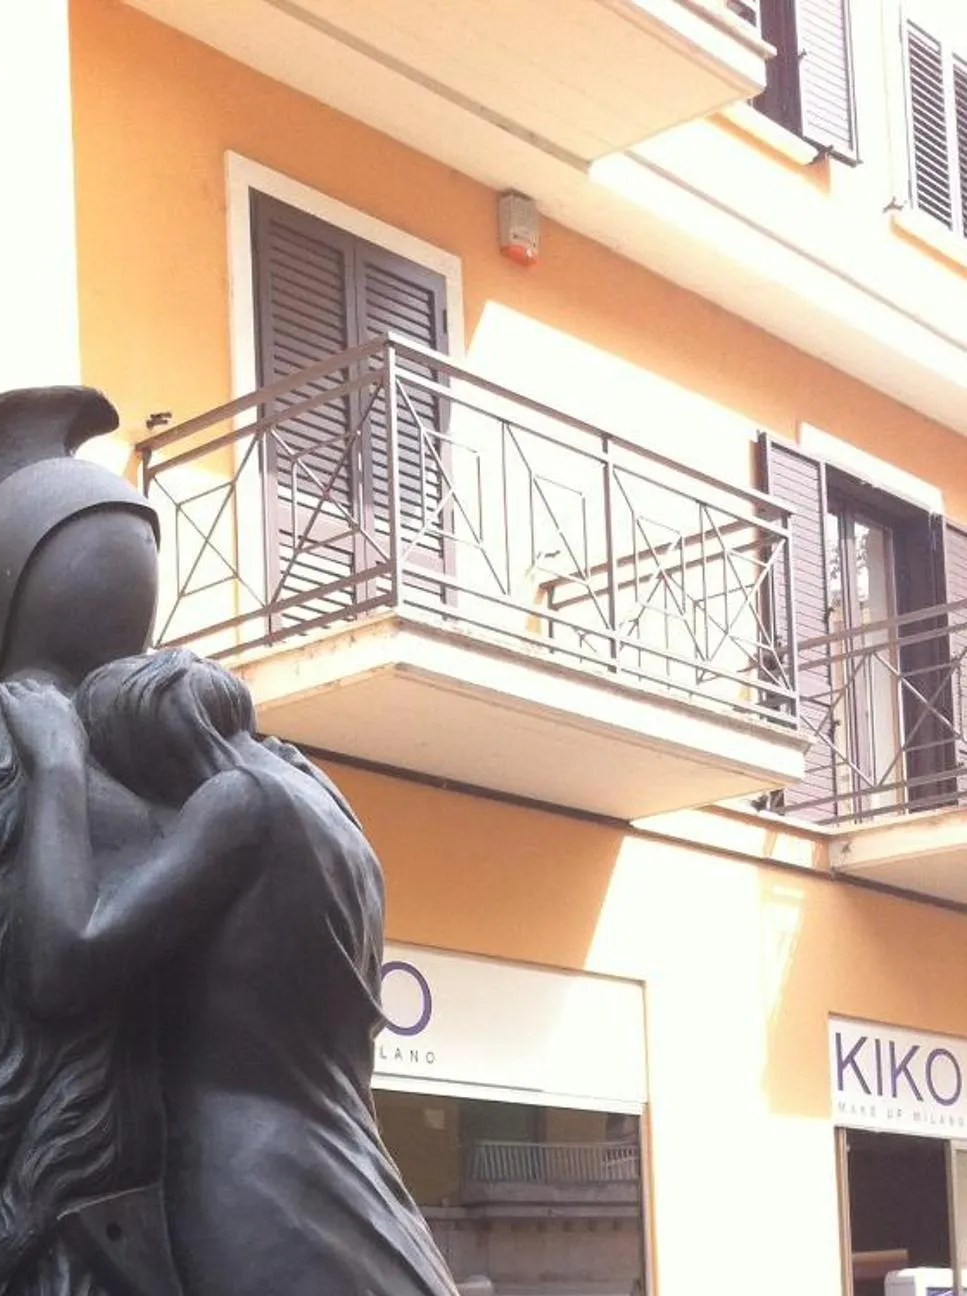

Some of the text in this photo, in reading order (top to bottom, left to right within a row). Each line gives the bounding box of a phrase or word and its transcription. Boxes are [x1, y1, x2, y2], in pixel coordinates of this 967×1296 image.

[379, 1044, 436, 1065] LANO
[835, 1032, 962, 1106] KIKO
[837, 1101, 876, 1118] MAKE
[913, 1111, 964, 1127] MILANO
